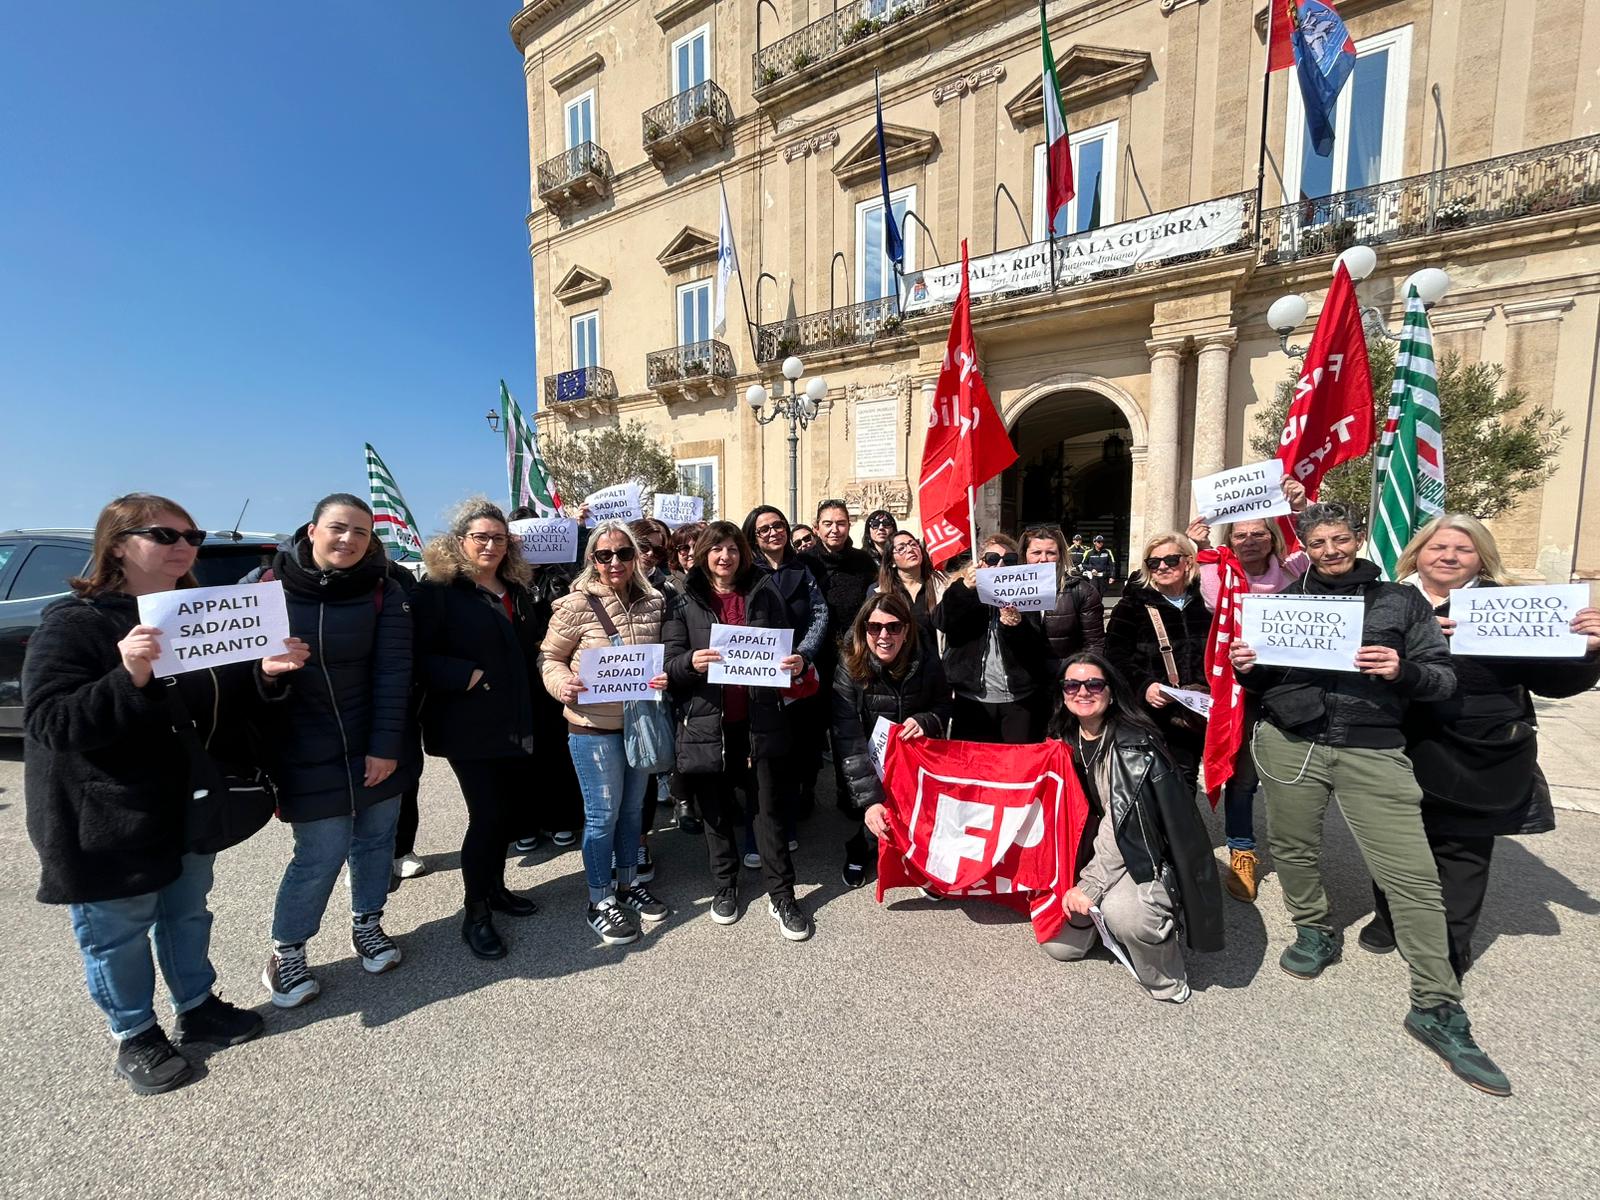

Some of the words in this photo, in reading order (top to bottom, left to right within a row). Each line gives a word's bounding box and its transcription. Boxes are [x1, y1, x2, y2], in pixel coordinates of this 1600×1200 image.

[1089, 238, 1114, 254] LA
[1214, 470, 1265, 489] APPALTI
[594, 490, 626, 500] APPALTI
[1216, 485, 1267, 502] SAD/ADI
[594, 500, 628, 510] SAD/ADI
[1214, 499, 1272, 517] TARANTO
[594, 511, 632, 521] TARANTO
[993, 572, 1038, 584] APPALTI
[993, 586, 1038, 596] SAD/ADI
[178, 595, 258, 616] APPALTI
[1471, 597, 1568, 610] LAVORO,
[1262, 609, 1346, 626] LAVORO,
[180, 616, 260, 637] SAD/ADI
[1477, 625, 1560, 637] SALARI.
[729, 634, 776, 647] APPALTI
[1266, 635, 1337, 651] SALARI.
[175, 635, 268, 660] TARANTO
[599, 653, 645, 665] APPALTI
[728, 649, 774, 661] SAD/ADI
[597, 667, 644, 678] SAD/ADI
[723, 664, 777, 677] TARANTO
[592, 682, 648, 694] TARANTO
[871, 732, 888, 764] APPALTI
